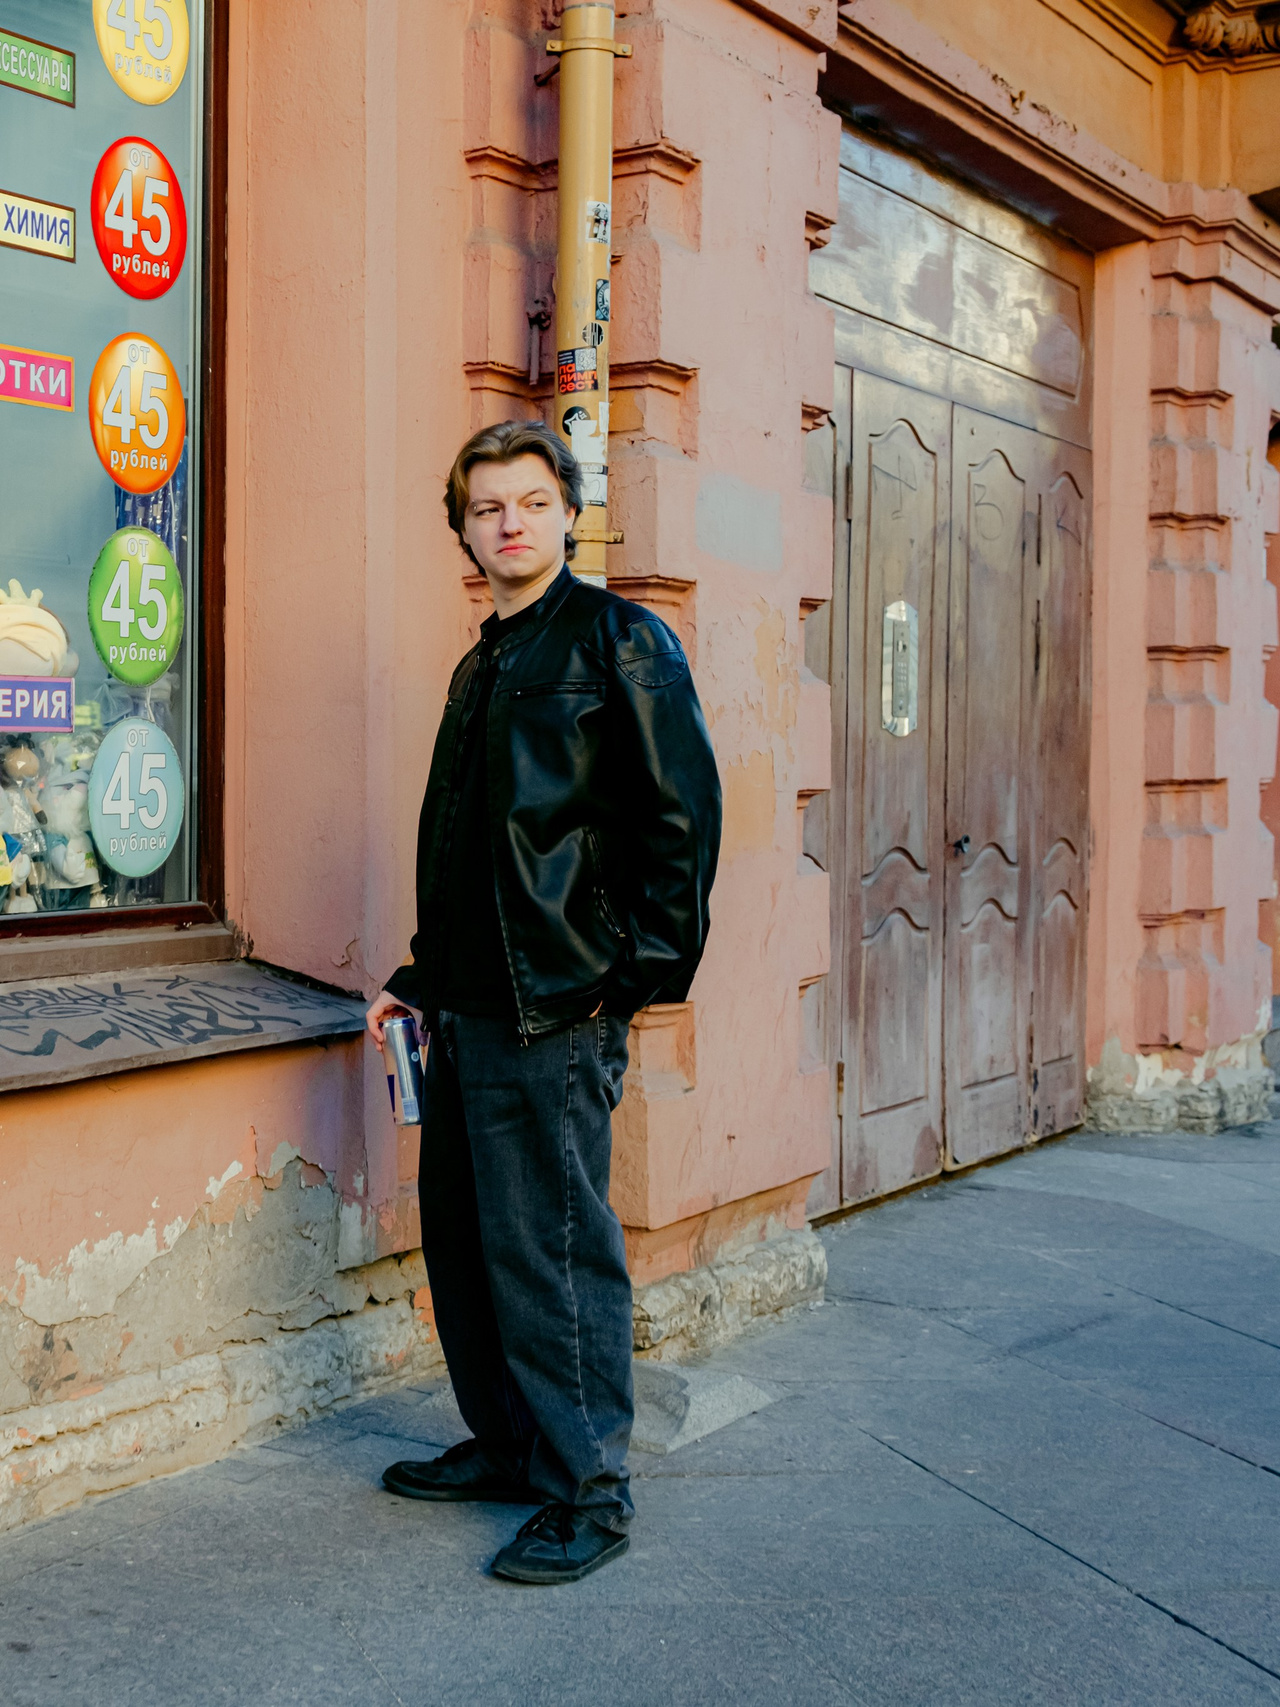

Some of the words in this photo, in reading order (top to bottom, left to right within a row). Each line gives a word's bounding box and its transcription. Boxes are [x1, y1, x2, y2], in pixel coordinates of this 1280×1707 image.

[106, 0, 173, 60] 45
[114, 53, 172, 85] рублей
[3, 202, 71, 248] ХИМИЯ
[104, 169, 171, 256] 45
[112, 251, 171, 280] рублей
[102, 365, 169, 449] 45
[110, 449, 168, 471] рублей
[101, 560, 167, 641] 45
[109, 645, 167, 664] рублей
[102, 752, 167, 830] 45
[109, 832, 168, 855] рублей
